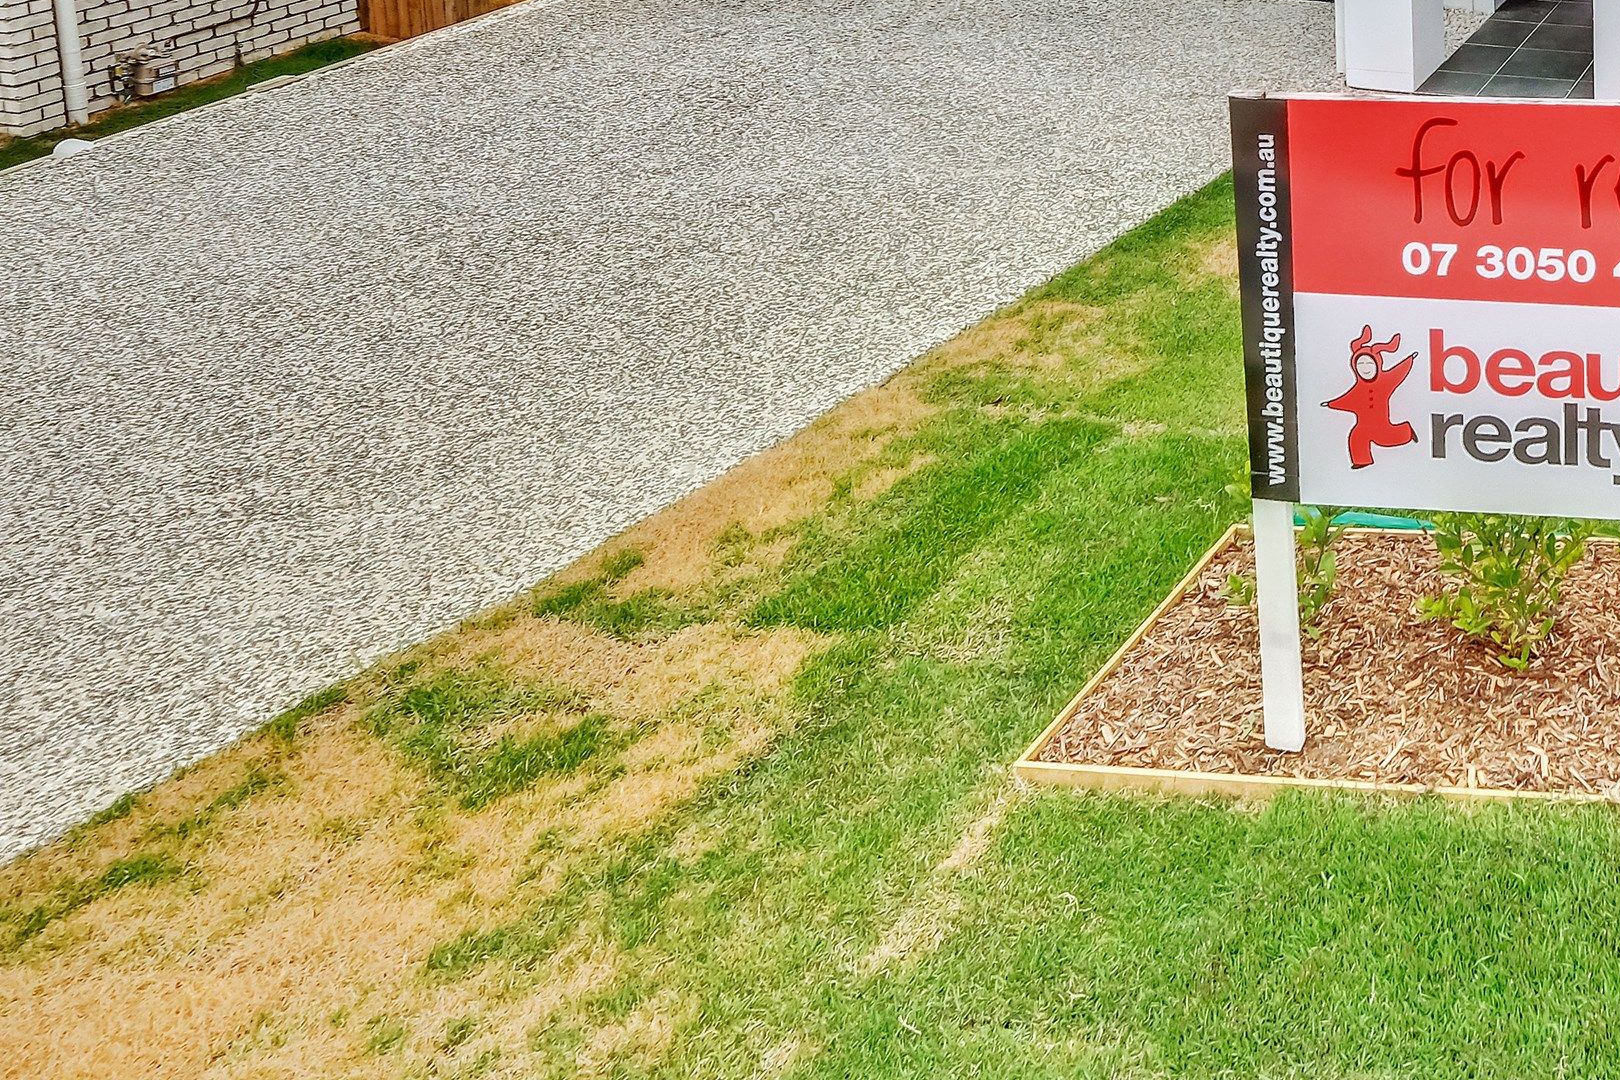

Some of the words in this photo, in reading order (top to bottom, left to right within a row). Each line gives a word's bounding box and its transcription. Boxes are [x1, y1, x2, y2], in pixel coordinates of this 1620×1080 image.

[1395, 117, 1525, 226] for
[1256, 133, 1287, 486] www.beautiquerealty.com.au
[1402, 243, 1457, 277] 07
[1475, 246, 1596, 283] 3050
